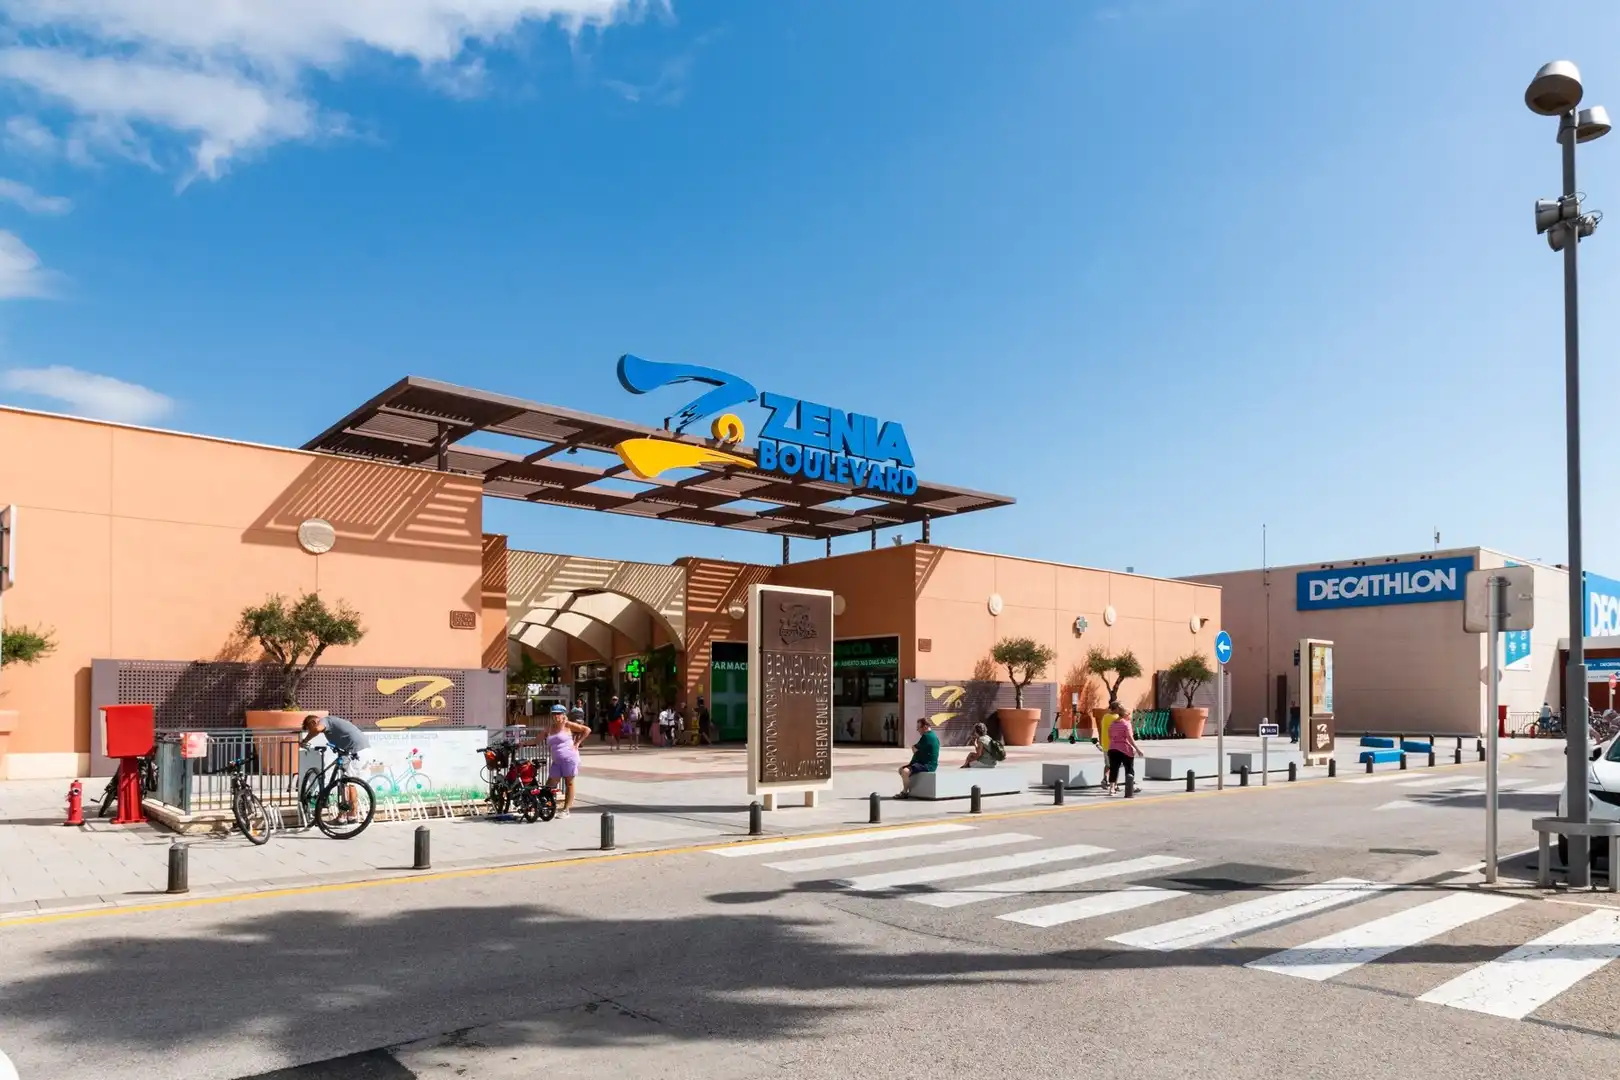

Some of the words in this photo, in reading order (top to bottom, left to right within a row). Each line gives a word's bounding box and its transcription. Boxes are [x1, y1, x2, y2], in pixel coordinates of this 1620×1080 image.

[759, 391, 916, 468] ZENIA
[758, 440, 918, 496] BOULEVARD
[1308, 567, 1457, 601] DECATHLON
[1590, 591, 1620, 637] DEC
[766, 654, 828, 677] BIENVENIDOS
[780, 677, 828, 695] WELCOME
[815, 695, 829, 758] BIENVENUE
